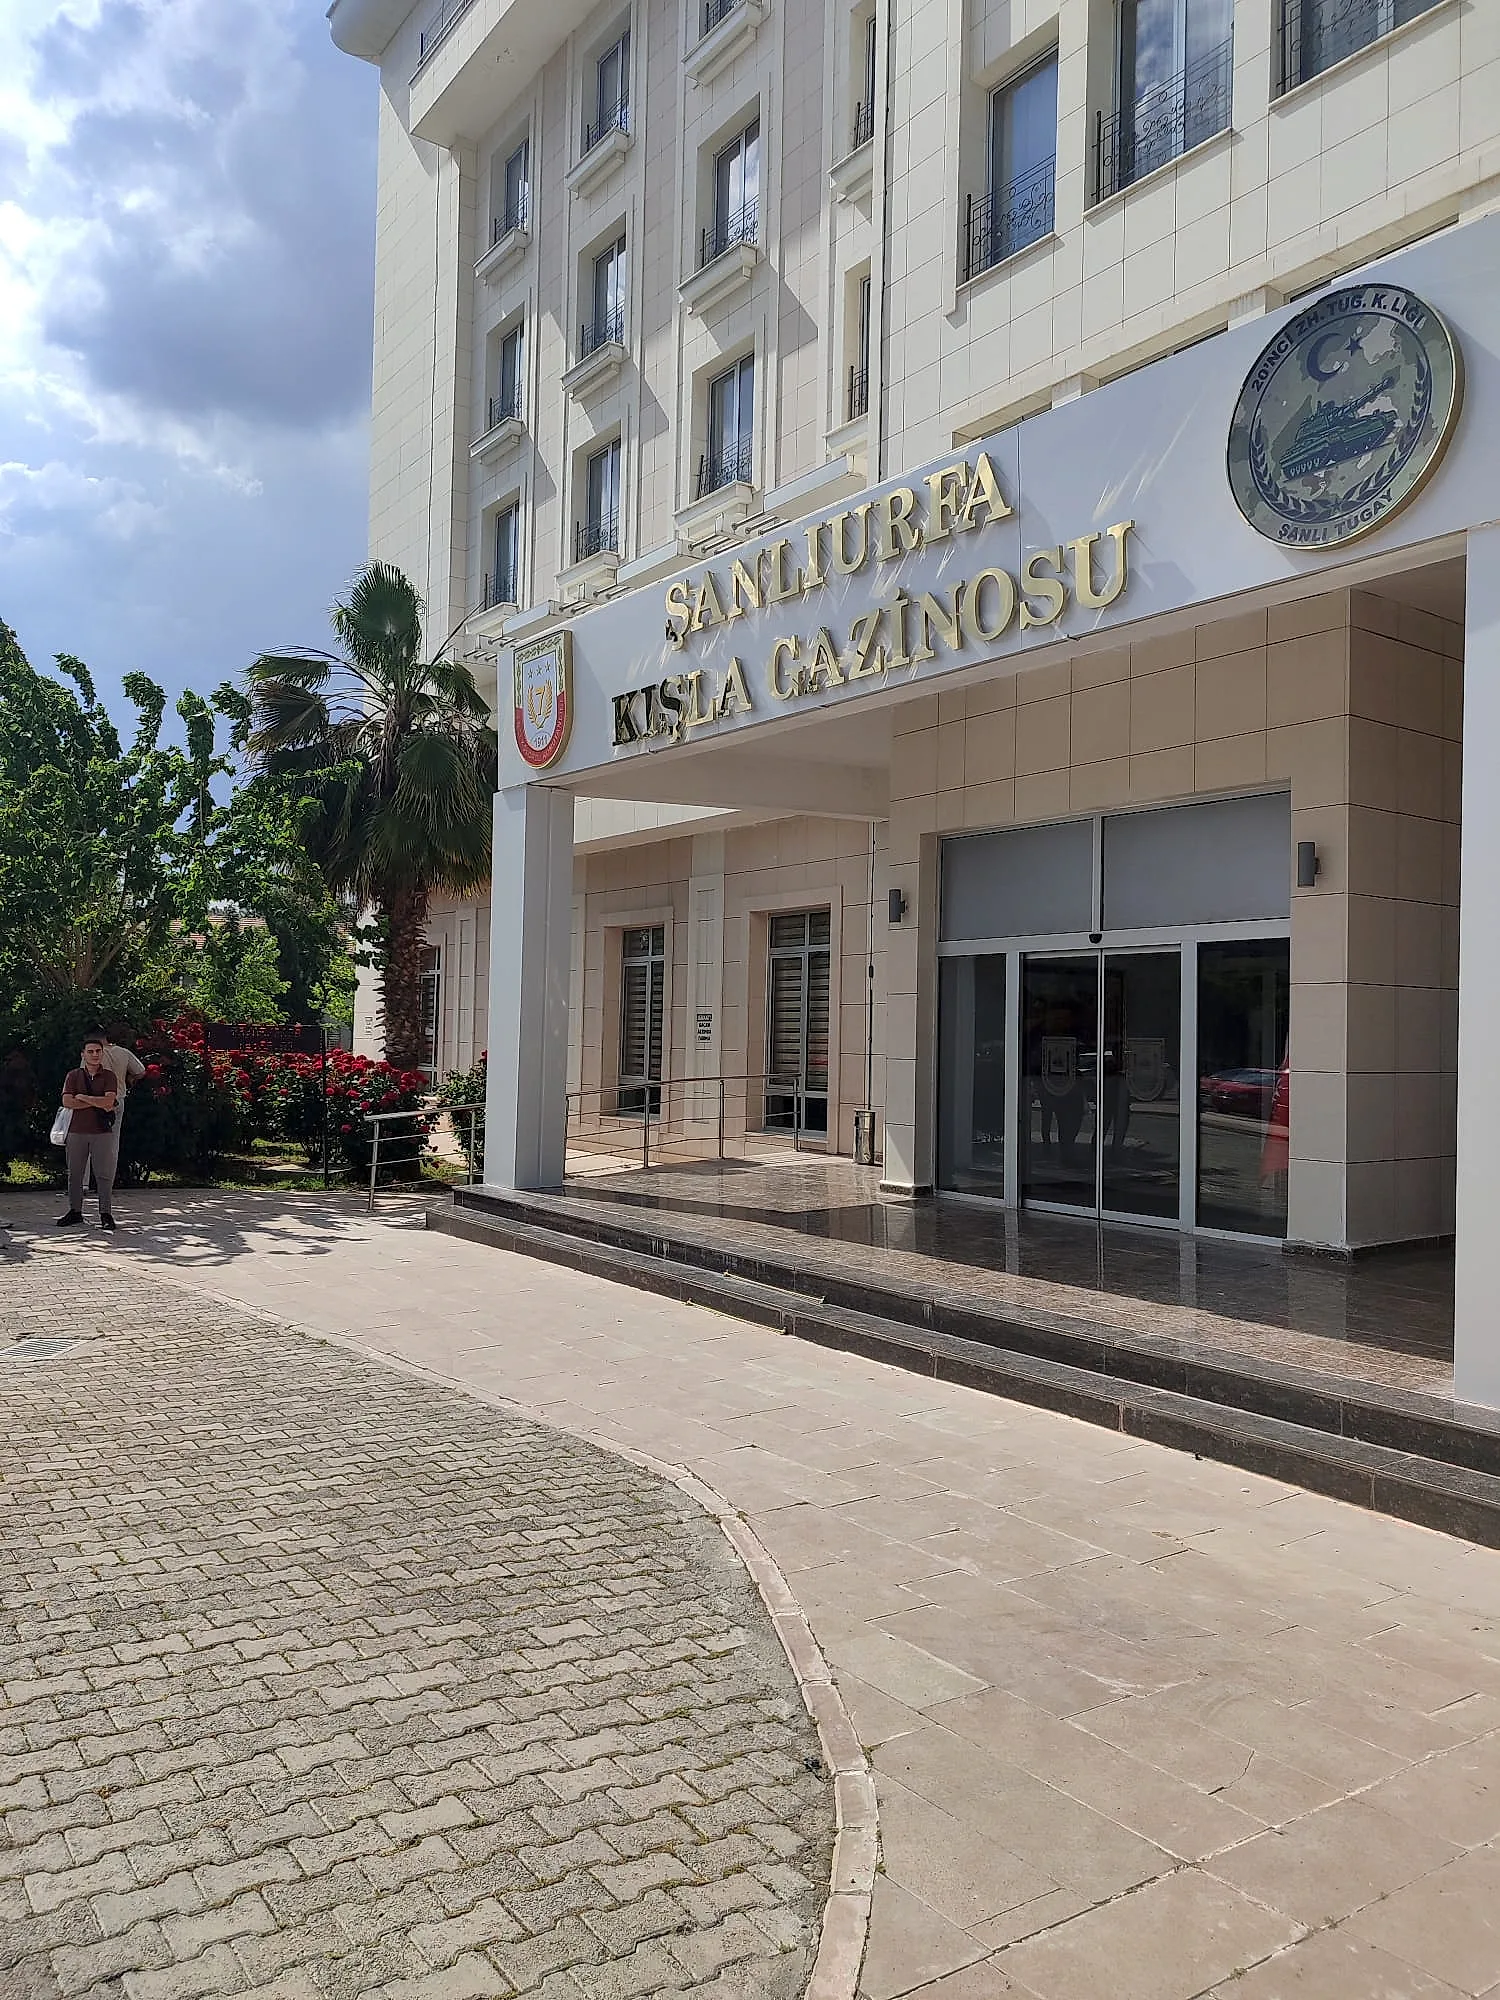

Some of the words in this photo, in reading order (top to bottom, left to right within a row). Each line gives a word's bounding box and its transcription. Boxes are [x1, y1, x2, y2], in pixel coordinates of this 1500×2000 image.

[664, 451, 1012, 651] ŞANLIURFA
[1278, 523, 1328, 541] ŞANLI
[1334, 488, 1393, 537] TUGAY
[611, 655, 752, 744] KIŞLA
[767, 519, 1135, 701] GAZİNOSU
